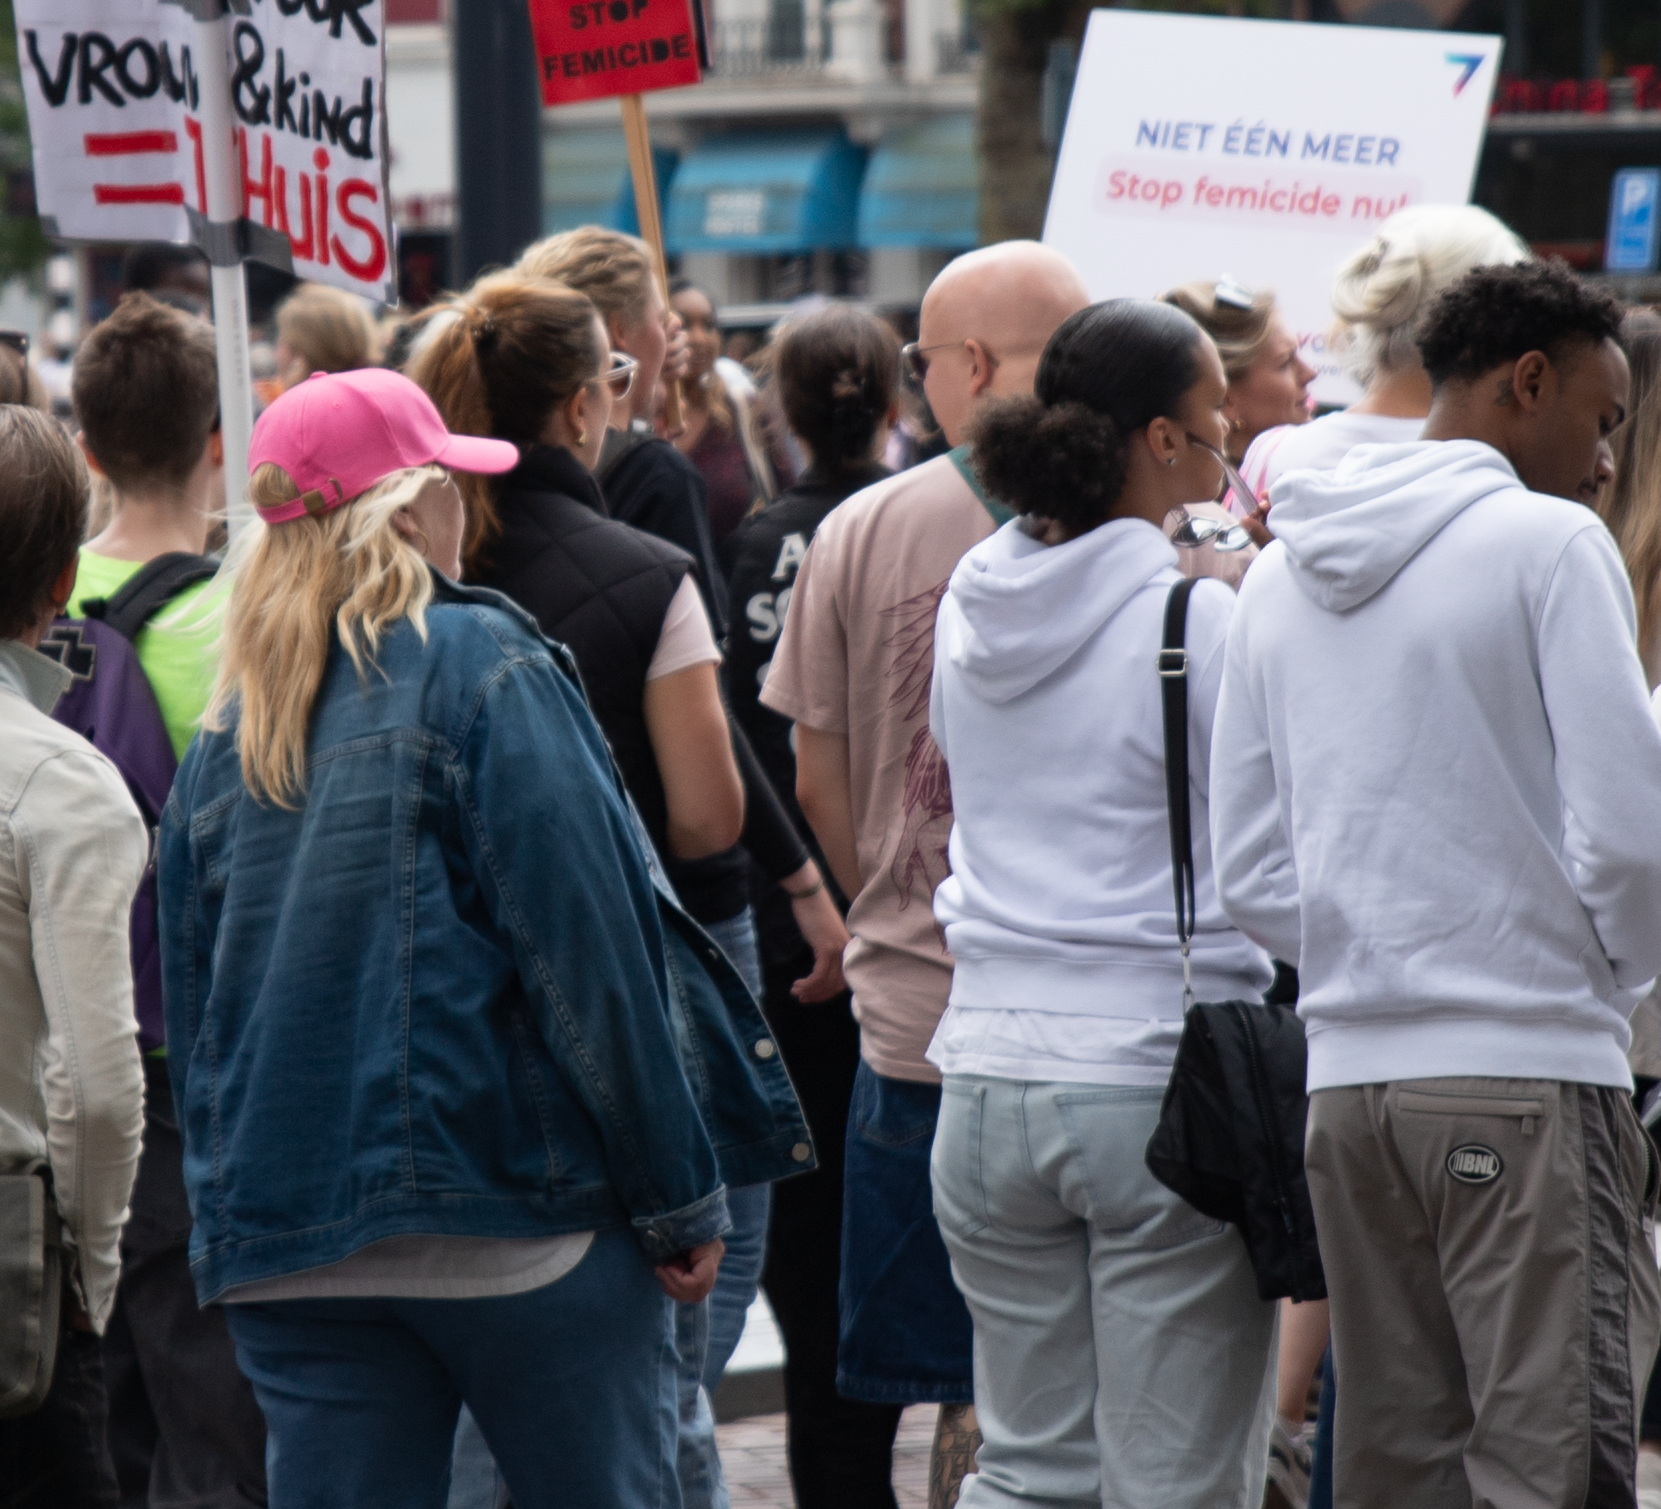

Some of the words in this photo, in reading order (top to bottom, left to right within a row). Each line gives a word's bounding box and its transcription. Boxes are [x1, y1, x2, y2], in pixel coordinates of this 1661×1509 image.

[543, 33, 690, 81] FEMICIDE
[1135, 118, 1215, 151] NIET
[1222, 116, 1292, 159] ÉÉN
[1301, 132, 1401, 167] MEER
[1106, 169, 1184, 212] Stop
[1193, 174, 1342, 217] femicide
